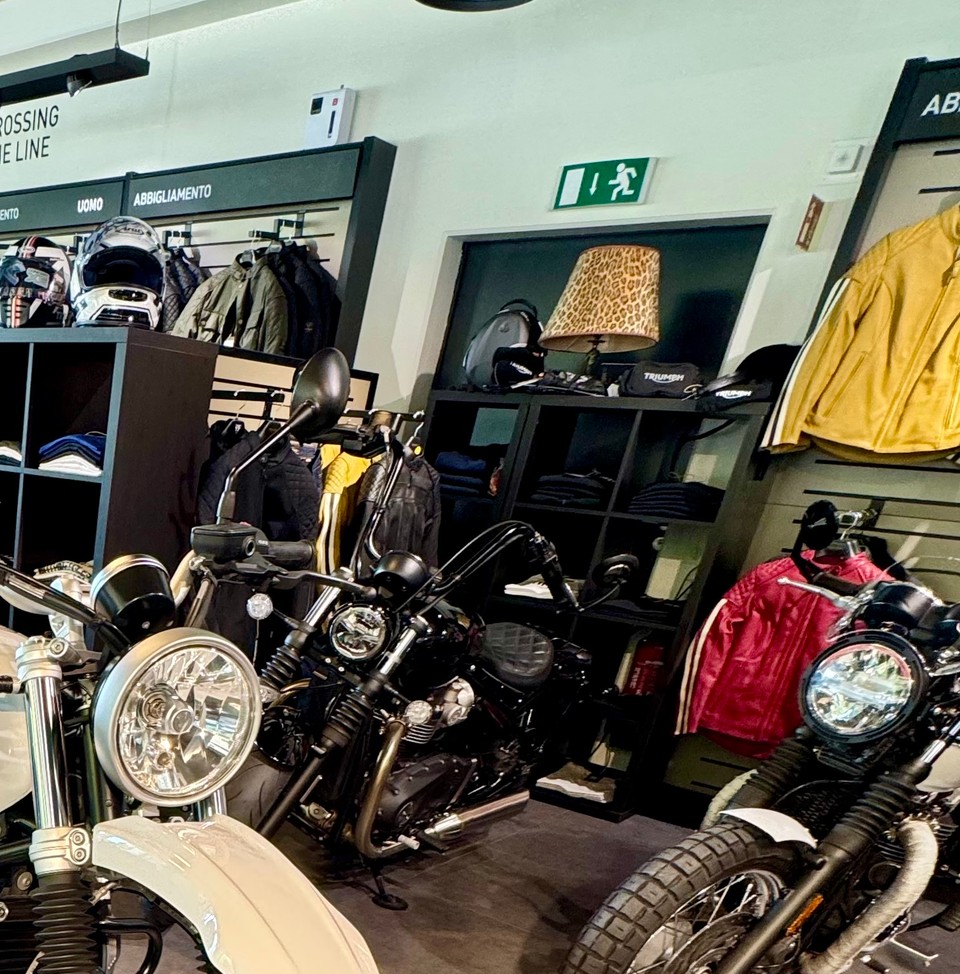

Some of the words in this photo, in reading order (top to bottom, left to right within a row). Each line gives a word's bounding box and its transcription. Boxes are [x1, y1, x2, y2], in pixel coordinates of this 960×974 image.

[920, 92, 960, 117] AB
[15, 135, 51, 162] LINE
[77, 197, 104, 213] UOMO
[133, 183, 212, 207] ABBIGLIAMENTO
[643, 372, 685, 383] TRIUMPH
